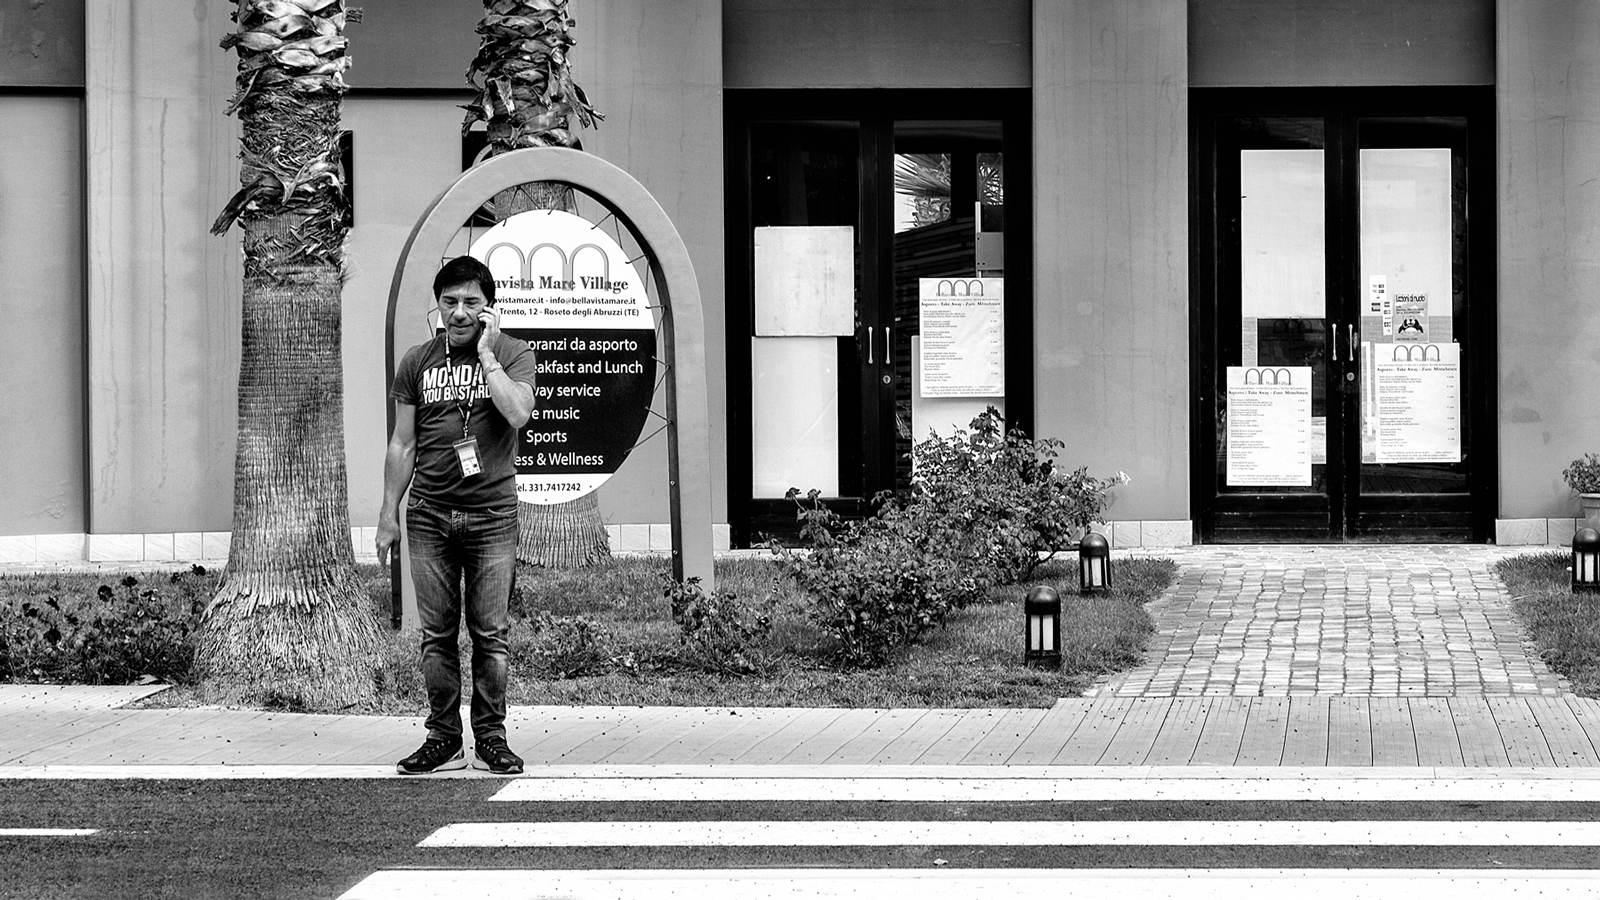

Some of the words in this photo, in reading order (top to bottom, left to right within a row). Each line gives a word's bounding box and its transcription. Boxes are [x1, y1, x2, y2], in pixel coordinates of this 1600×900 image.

[494, 275, 534, 291] avista
[539, 275, 576, 291] Mare
[580, 275, 629, 294] Village
[550, 296, 636, 305] info@bellavistamare.it
[499, 307, 527, 316] Trento,
[544, 308, 571, 316] Roseto
[572, 308, 592, 318] degli
[593, 308, 623, 316] Abruzzi
[624, 308, 640, 317] (TE)
[528, 337, 567, 351] pranzi
[570, 336, 586, 351] da
[589, 338, 638, 354] asporto
[577, 360, 602, 374] and
[605, 360, 644, 374] Lunch
[422, 364, 489, 391] MONDA
[422, 387, 442, 404] YOU
[557, 383, 601, 397] service
[543, 406, 580, 420] music
[526, 429, 568, 446] Sports
[536, 452, 547, 466] &
[549, 451, 604, 466] Wellness
[528, 482, 581, 492] 331.7417242
